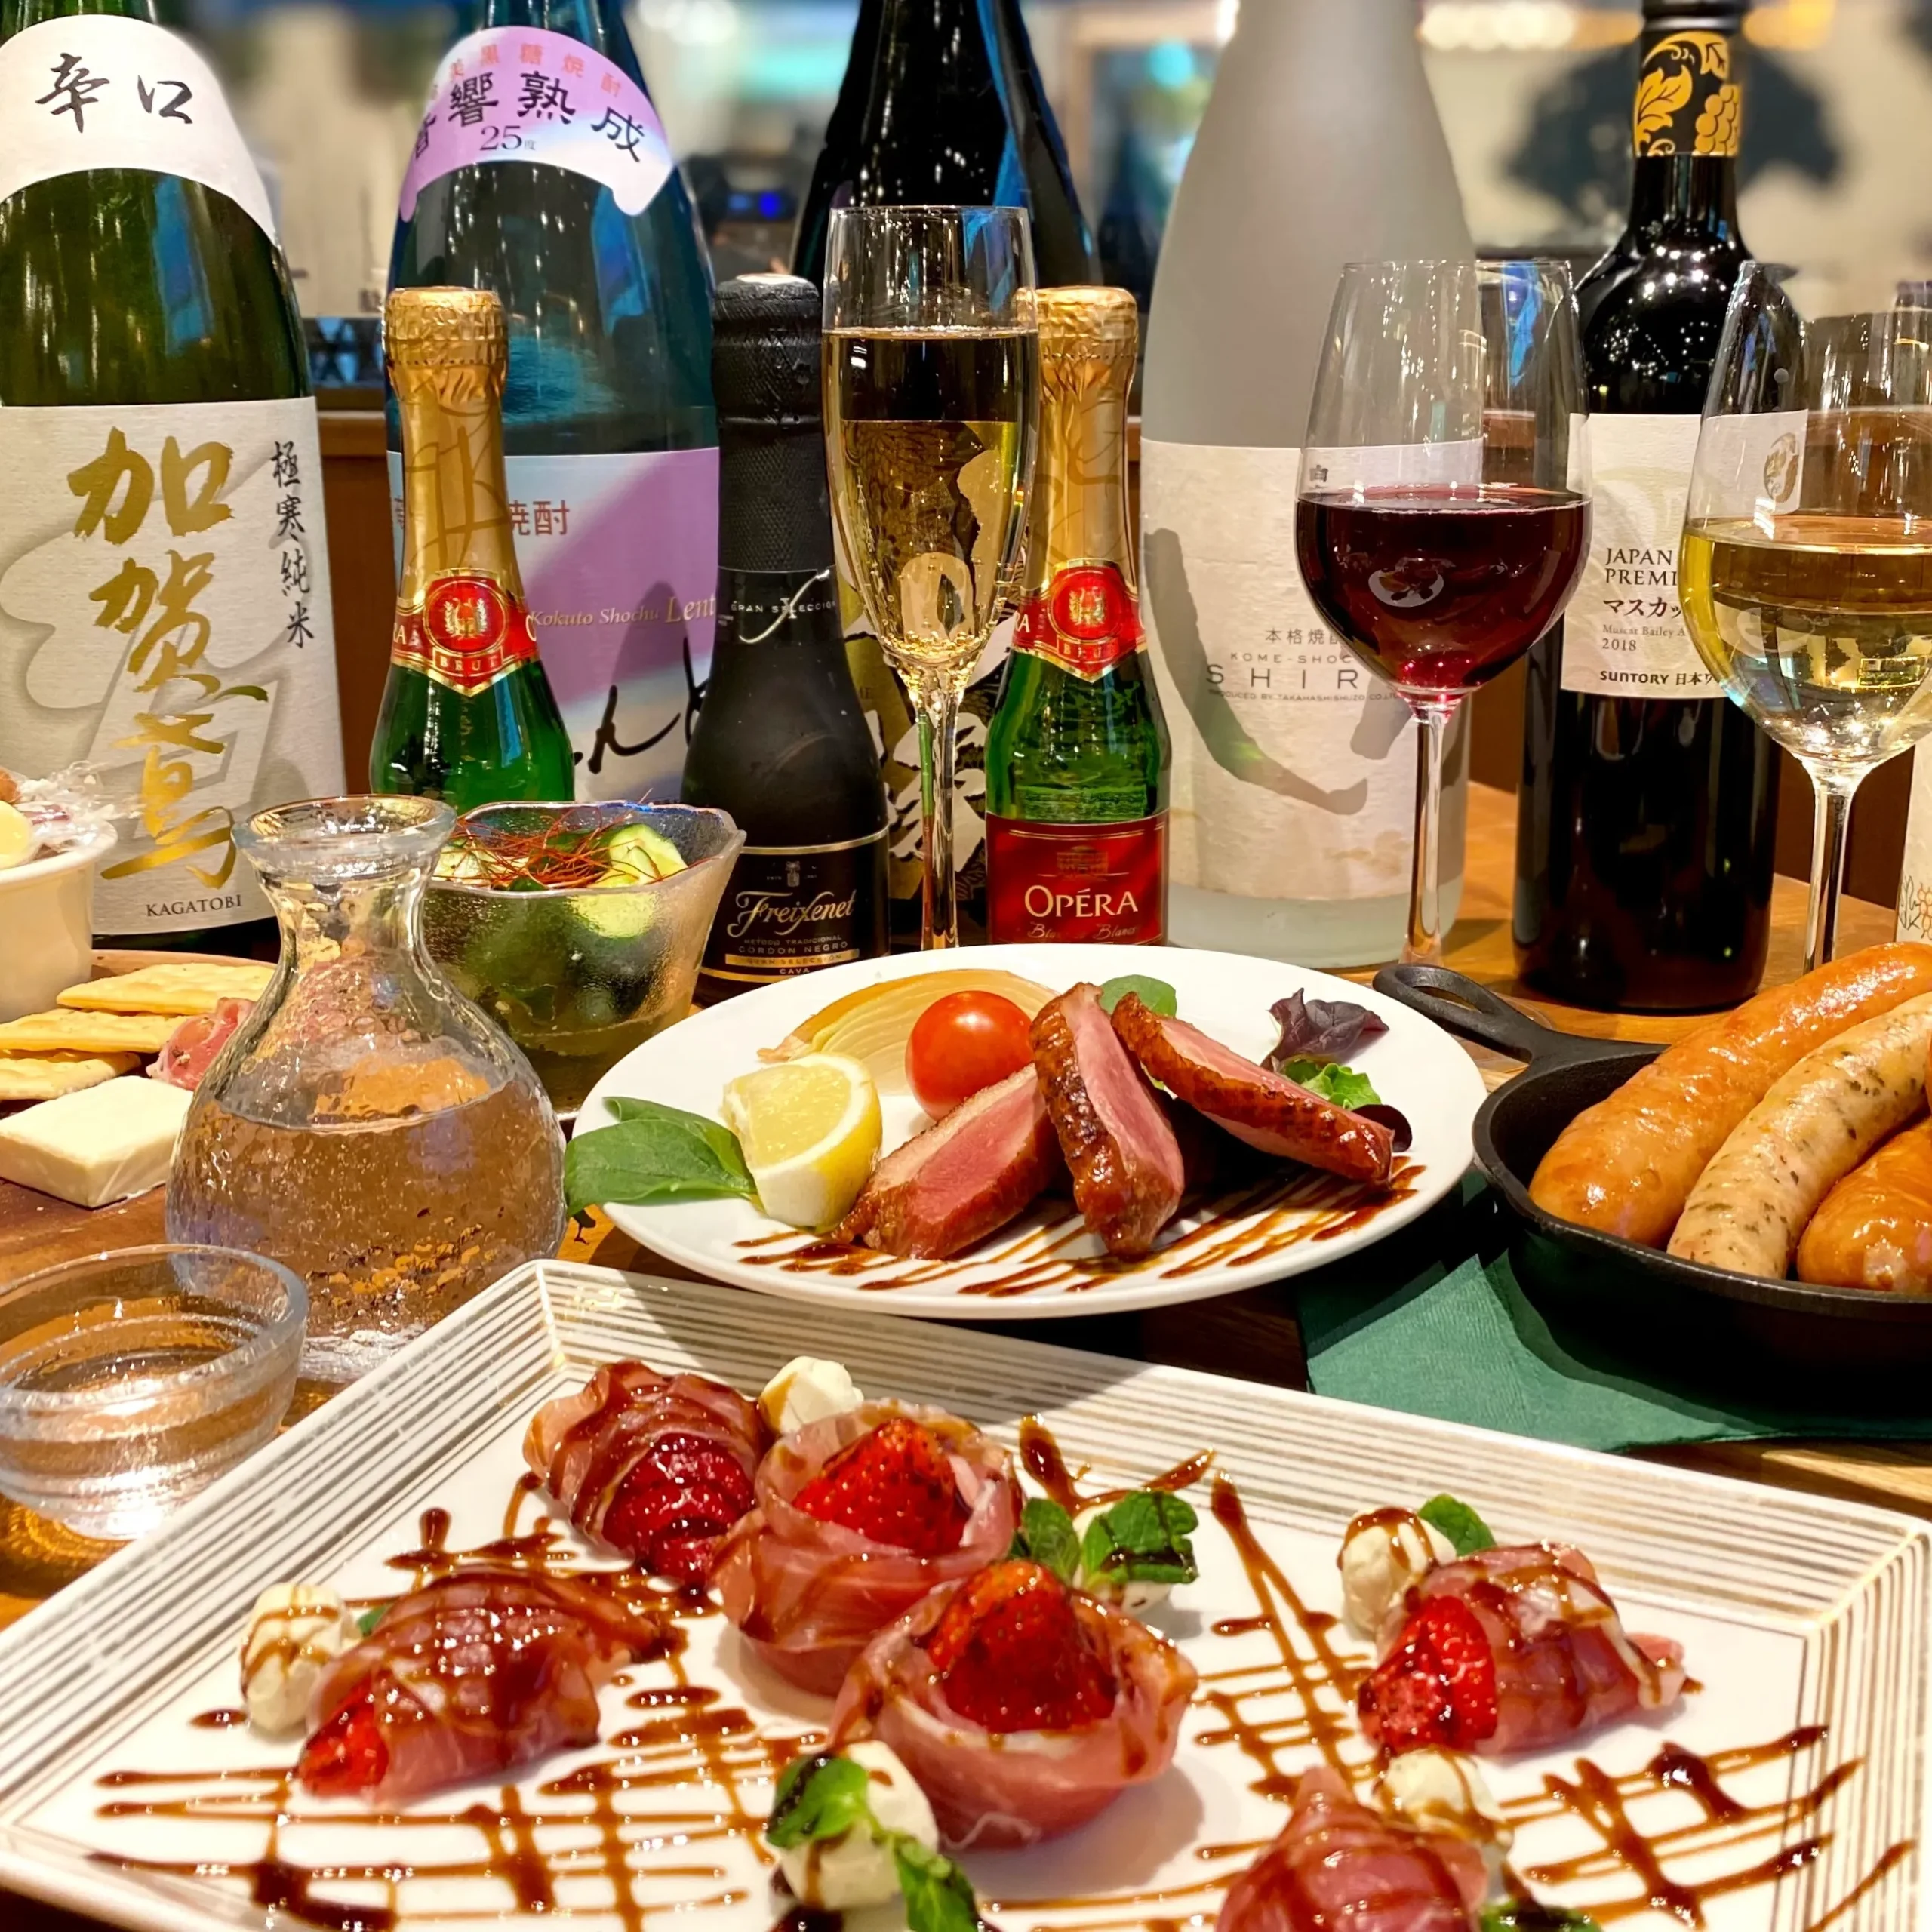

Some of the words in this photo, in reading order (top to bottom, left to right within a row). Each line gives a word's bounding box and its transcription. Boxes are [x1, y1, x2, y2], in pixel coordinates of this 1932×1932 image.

[429, 43, 622, 100] 美黒糖焼酎
[269, 440, 315, 649] 極寒純米
[1605, 547, 1673, 566] JAPAN
[530, 609, 594, 626] Kokuto
[598, 605, 660, 624] Shochu
[1641, 626, 1675, 638] Bailey
[1601, 638, 1637, 651] 2018
[145, 893, 243, 918] KAGATOBI
[1024, 884, 1139, 918] OPÉRA
[726, 889, 857, 938] Freixenet
[804, 941, 848, 953] NEGRO
